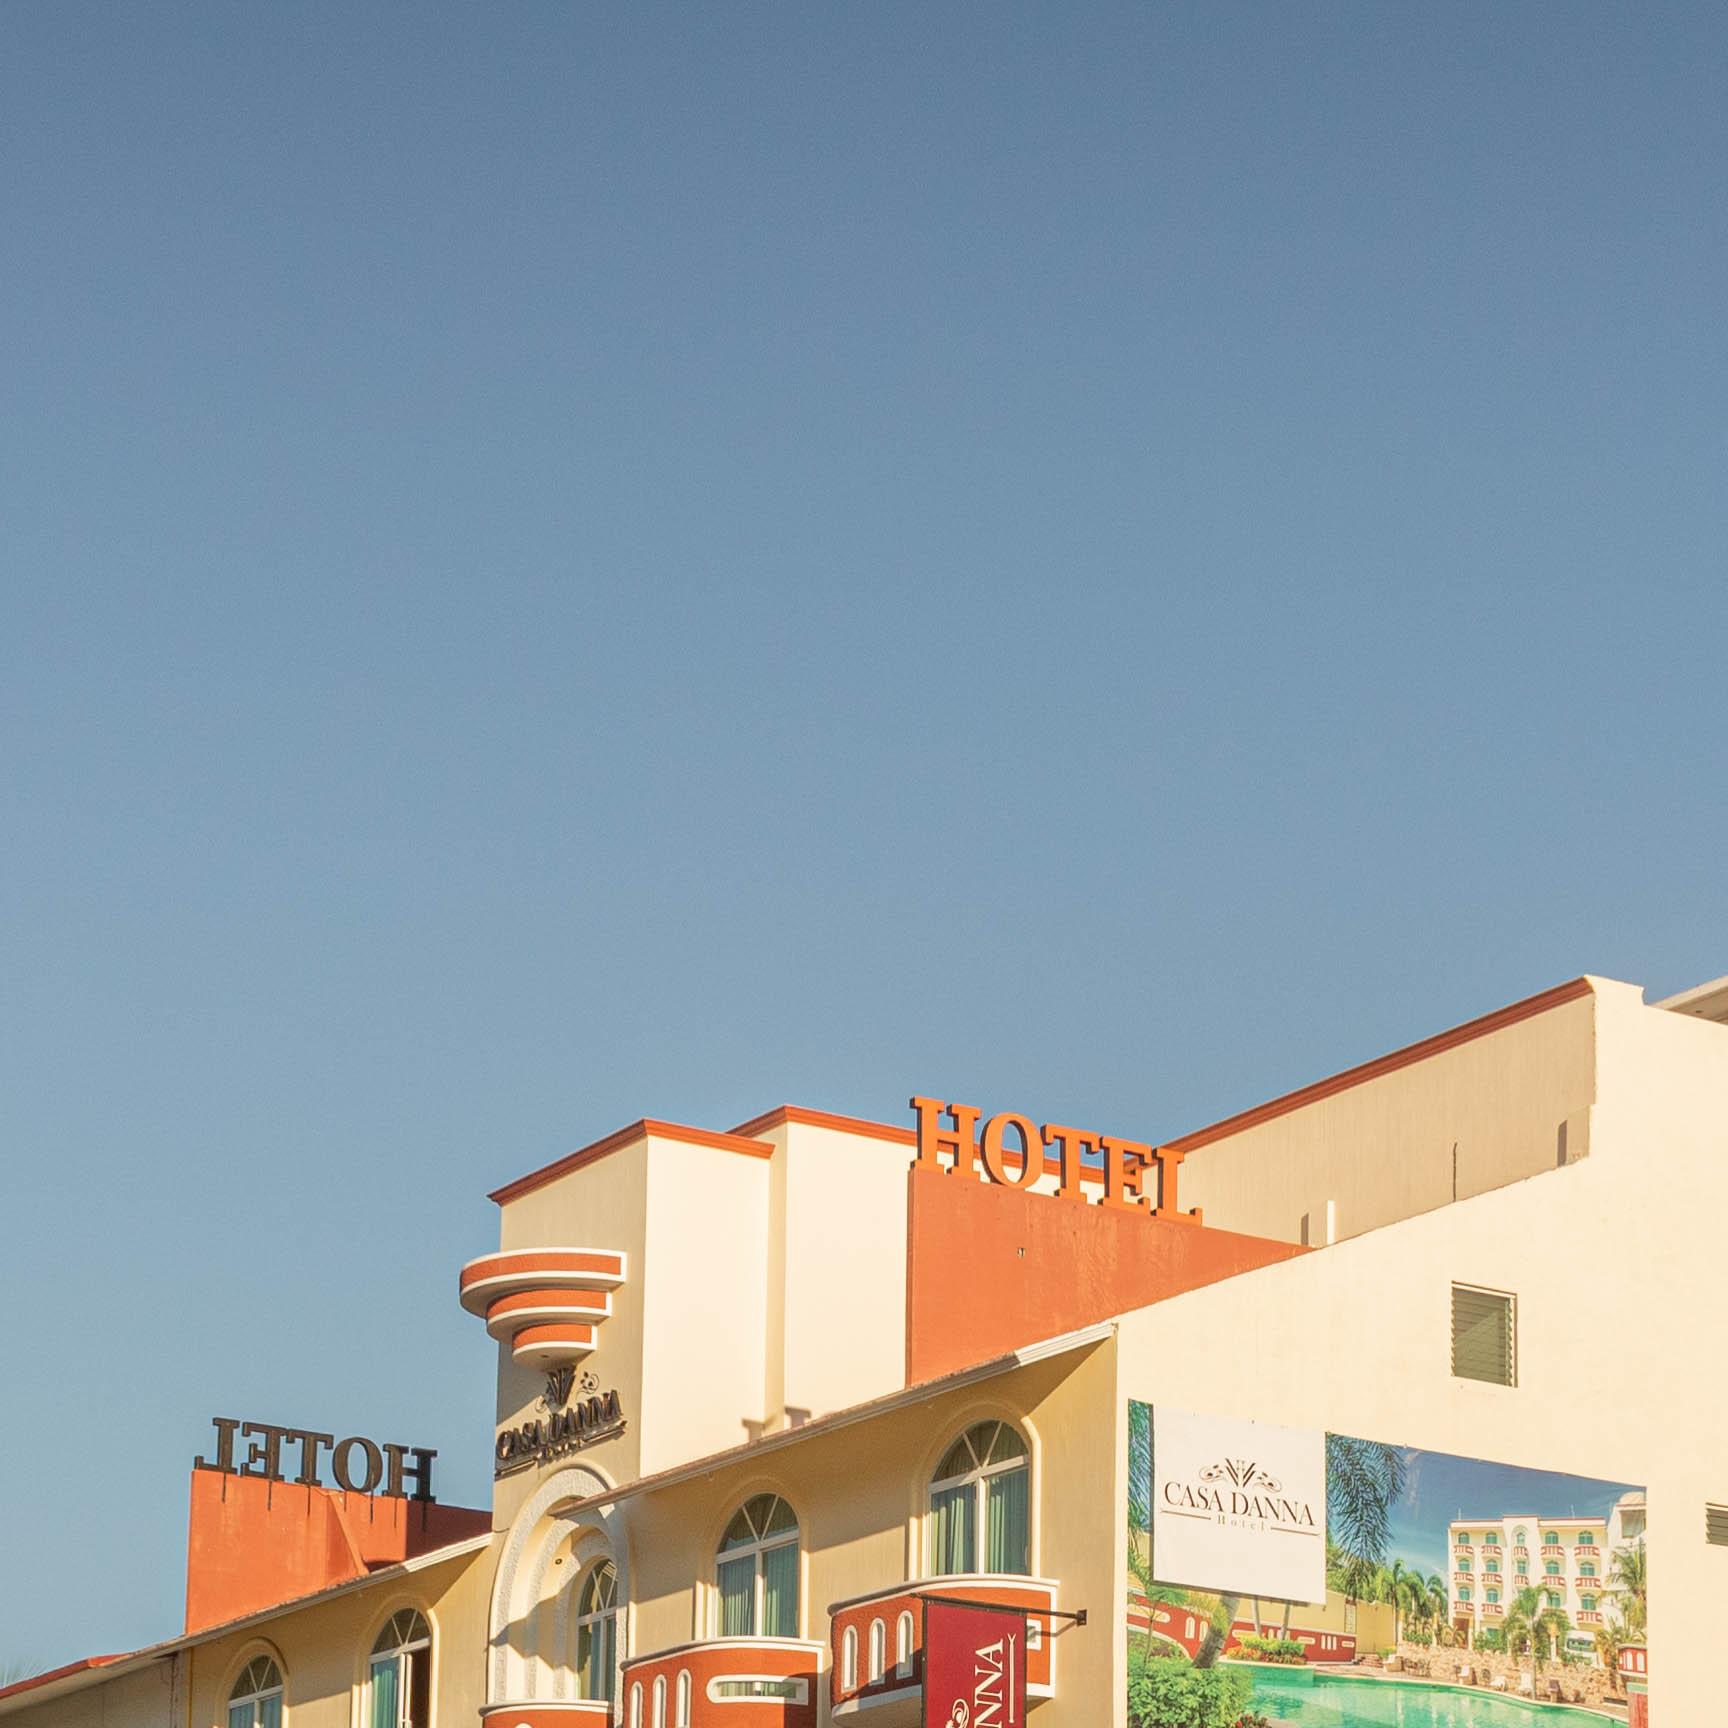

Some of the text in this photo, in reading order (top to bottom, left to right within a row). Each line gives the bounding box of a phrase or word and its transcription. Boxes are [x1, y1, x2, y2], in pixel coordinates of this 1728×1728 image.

[910, 1096, 1202, 1224] HOTEL
[1164, 1481, 1316, 1527] CASA DANNA
[1217, 1514, 1267, 1532] Hotel
